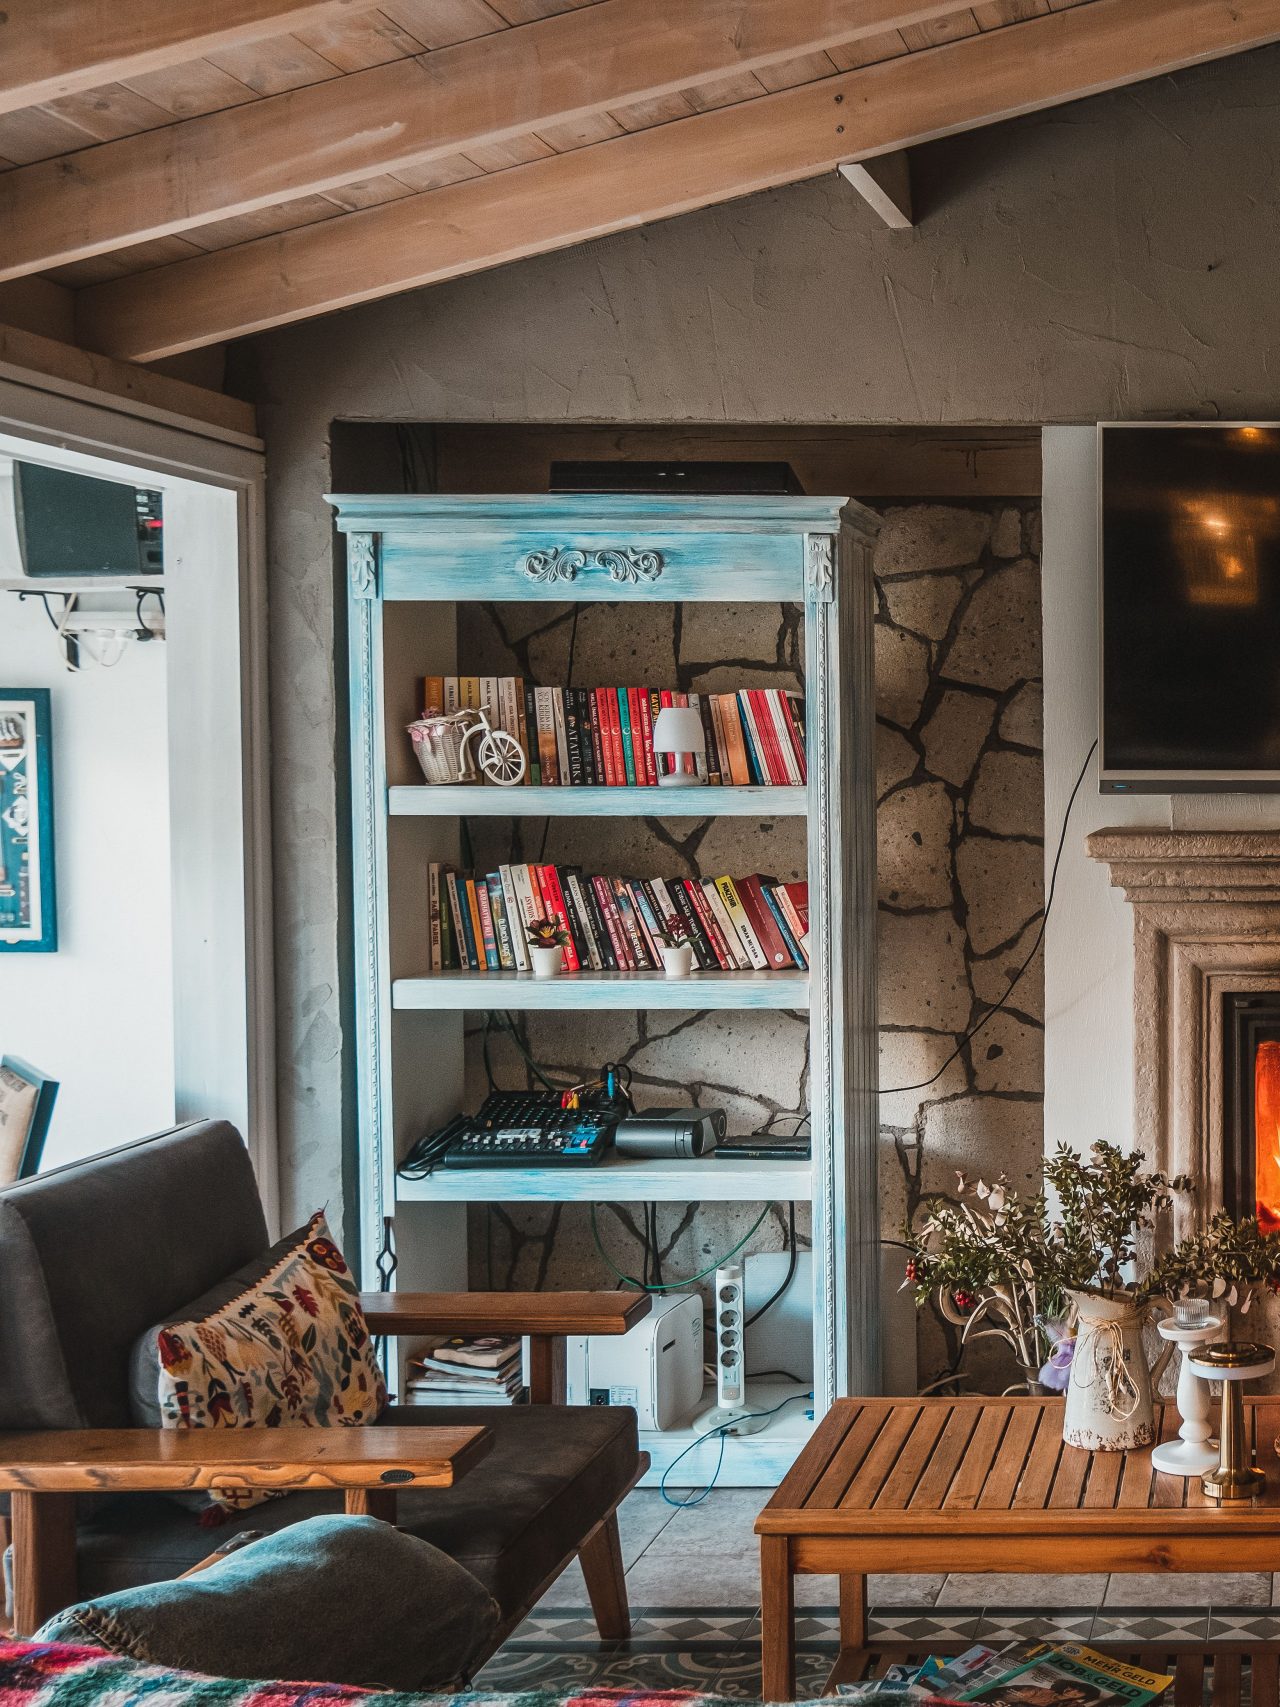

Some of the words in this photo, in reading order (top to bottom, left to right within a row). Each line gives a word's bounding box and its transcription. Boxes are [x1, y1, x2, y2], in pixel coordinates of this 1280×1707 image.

[650, 693, 658, 714] KAYIP
[568, 727, 582, 777] ATATÜRK
[720, 881, 737, 908] PANZEHİR
[625, 919, 635, 932] ALEV
[630, 931, 644, 959] DENEYLERİ
[739, 924, 750, 939] SİNAN
[746, 938, 759, 959] MEYDAN
[1083, 1655, 1121, 1677] MEHR
[1122, 1671, 1156, 1686] GELD
